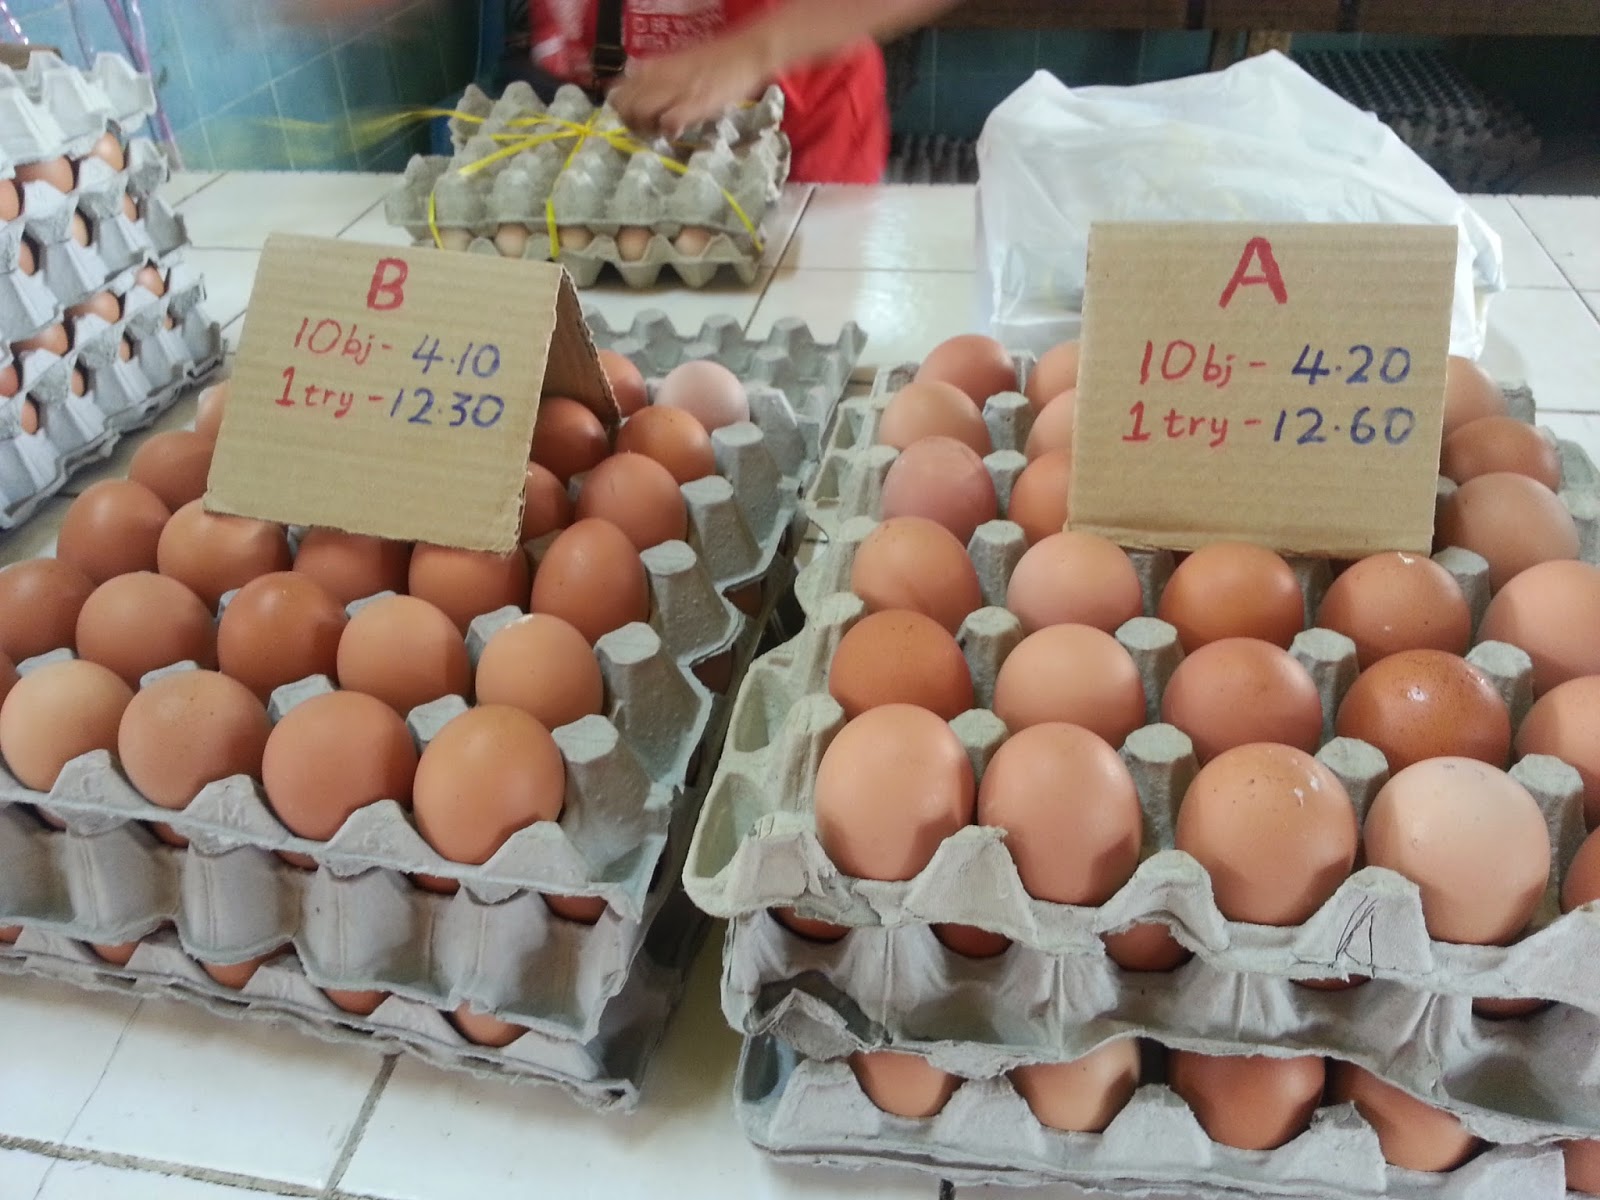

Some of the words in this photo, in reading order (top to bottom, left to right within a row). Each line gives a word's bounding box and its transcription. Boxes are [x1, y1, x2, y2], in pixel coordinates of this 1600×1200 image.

[367, 257, 410, 312] B
[1218, 236, 1289, 309] A
[411, 334, 501, 379] 4.10
[1291, 344, 1411, 385] 4.20
